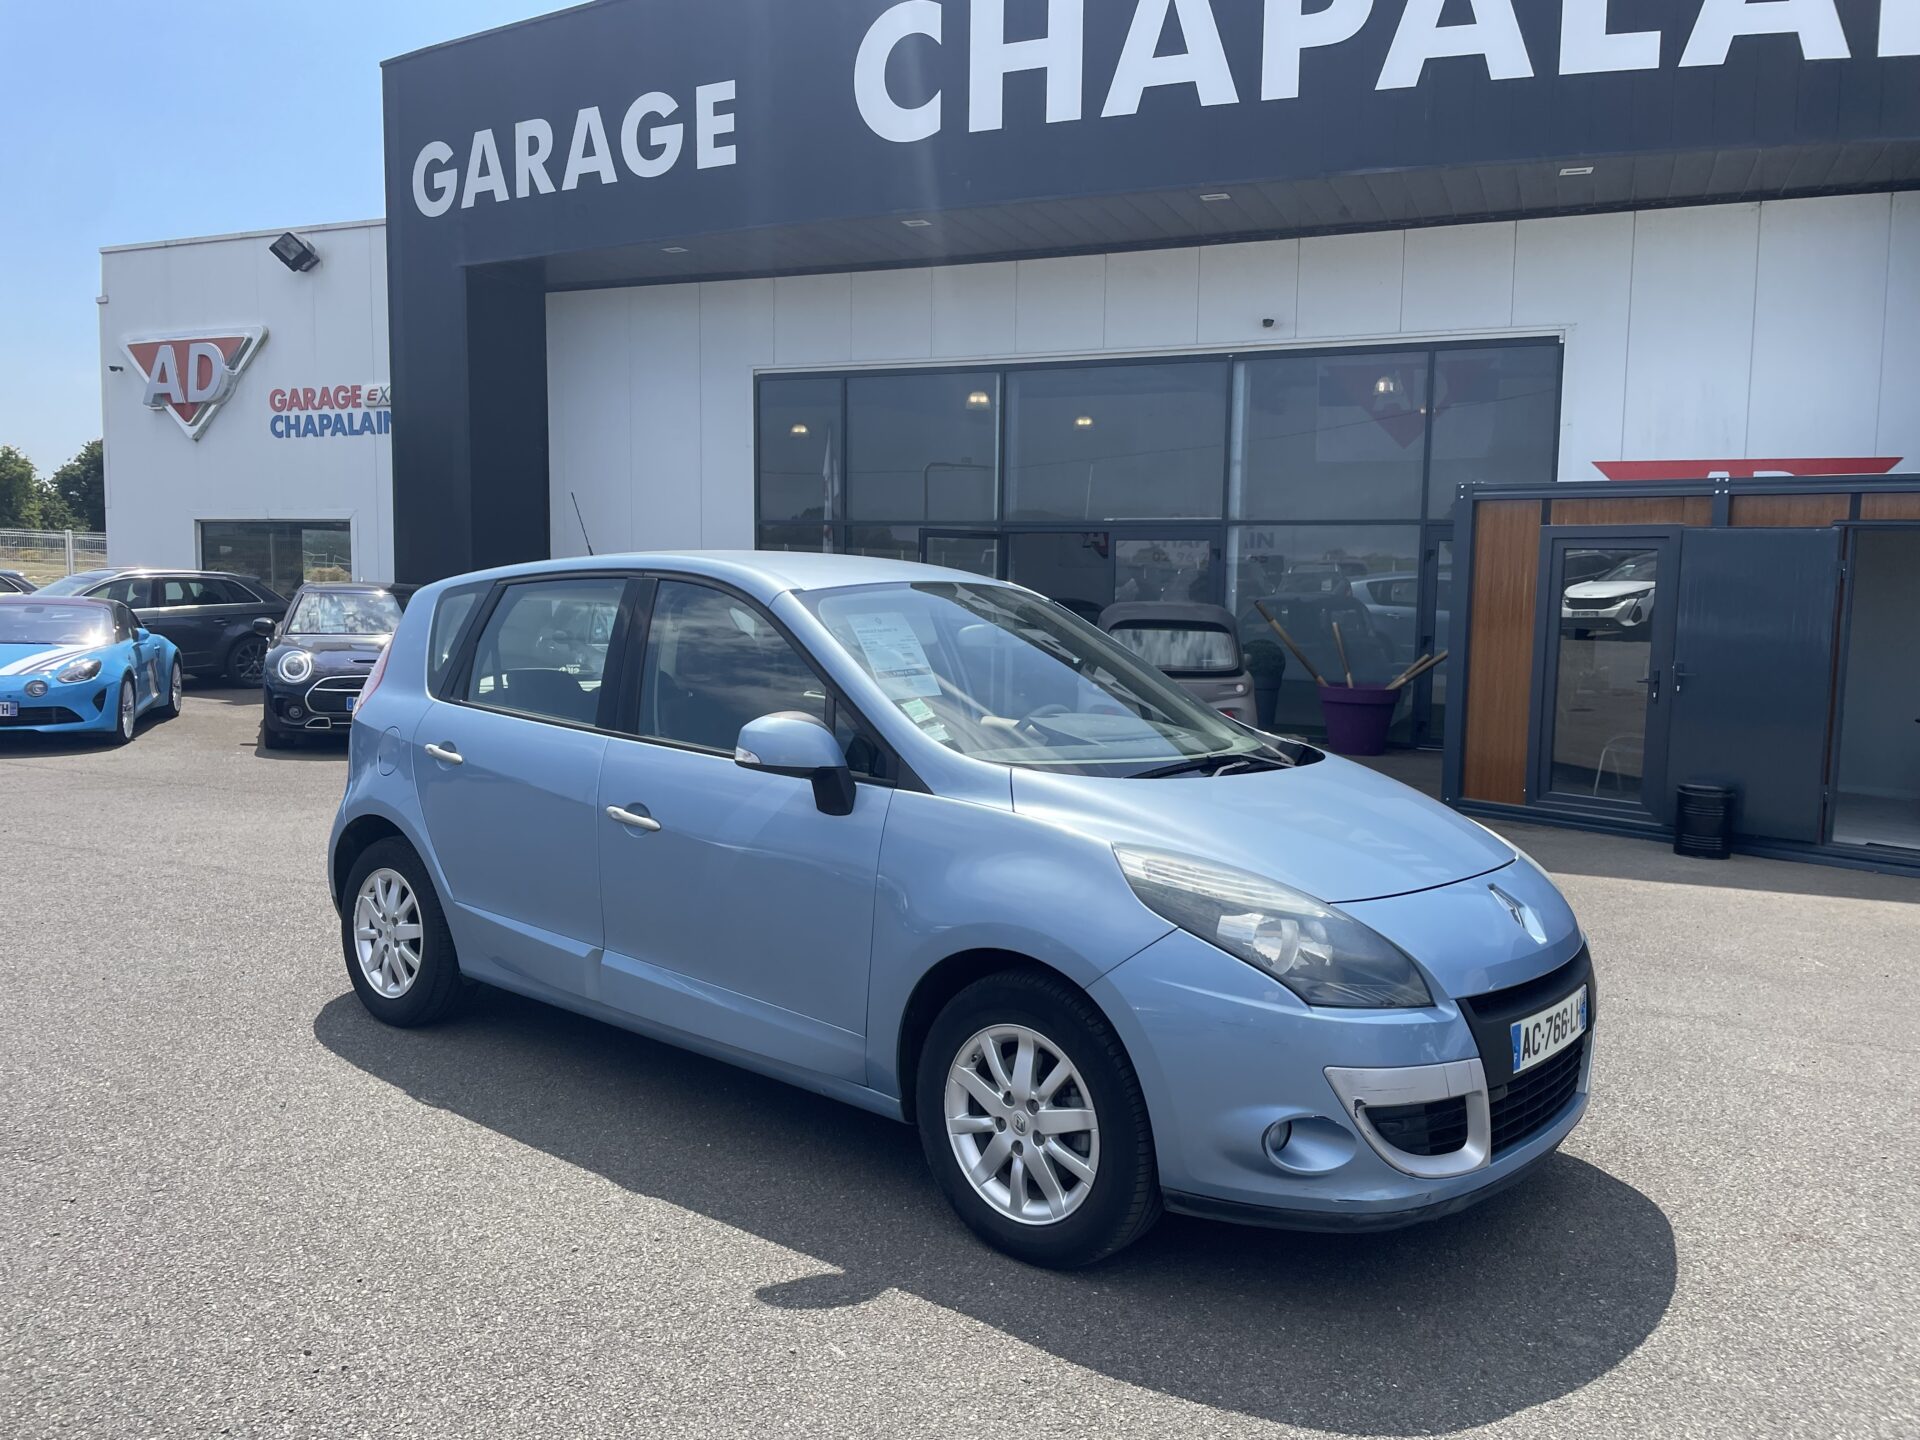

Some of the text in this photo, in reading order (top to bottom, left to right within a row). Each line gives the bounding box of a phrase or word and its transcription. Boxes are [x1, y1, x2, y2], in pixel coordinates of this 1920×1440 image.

[412, 80, 738, 218] GARAGE
[143, 342, 228, 405] AD
[269, 385, 362, 412] GARAGE
[1244, 532, 1275, 549] IN
